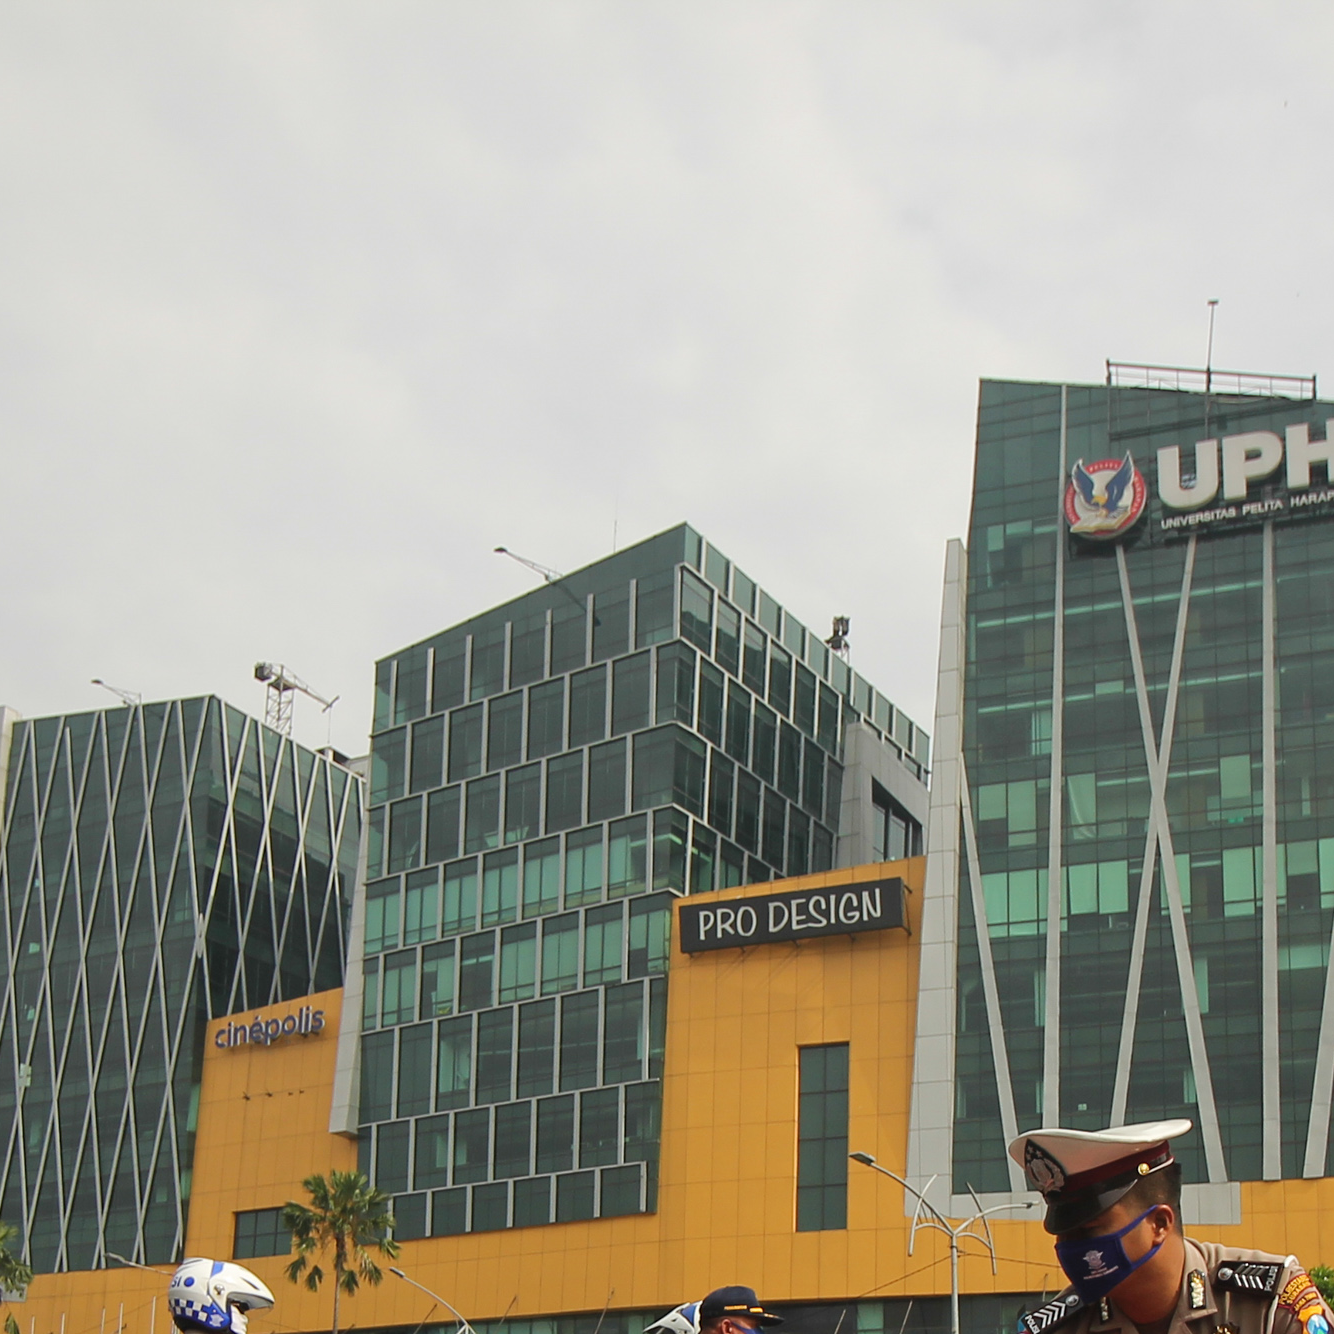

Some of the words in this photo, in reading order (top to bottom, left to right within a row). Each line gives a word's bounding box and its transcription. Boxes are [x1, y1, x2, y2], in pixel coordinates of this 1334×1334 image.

[1161, 506, 1237, 530] UNIVERSITAS
[1242, 499, 1283, 517] PELITA
[699, 905, 758, 941] PRO
[768, 887, 882, 934] DESIGN
[214, 1005, 326, 1050] cinépolis
